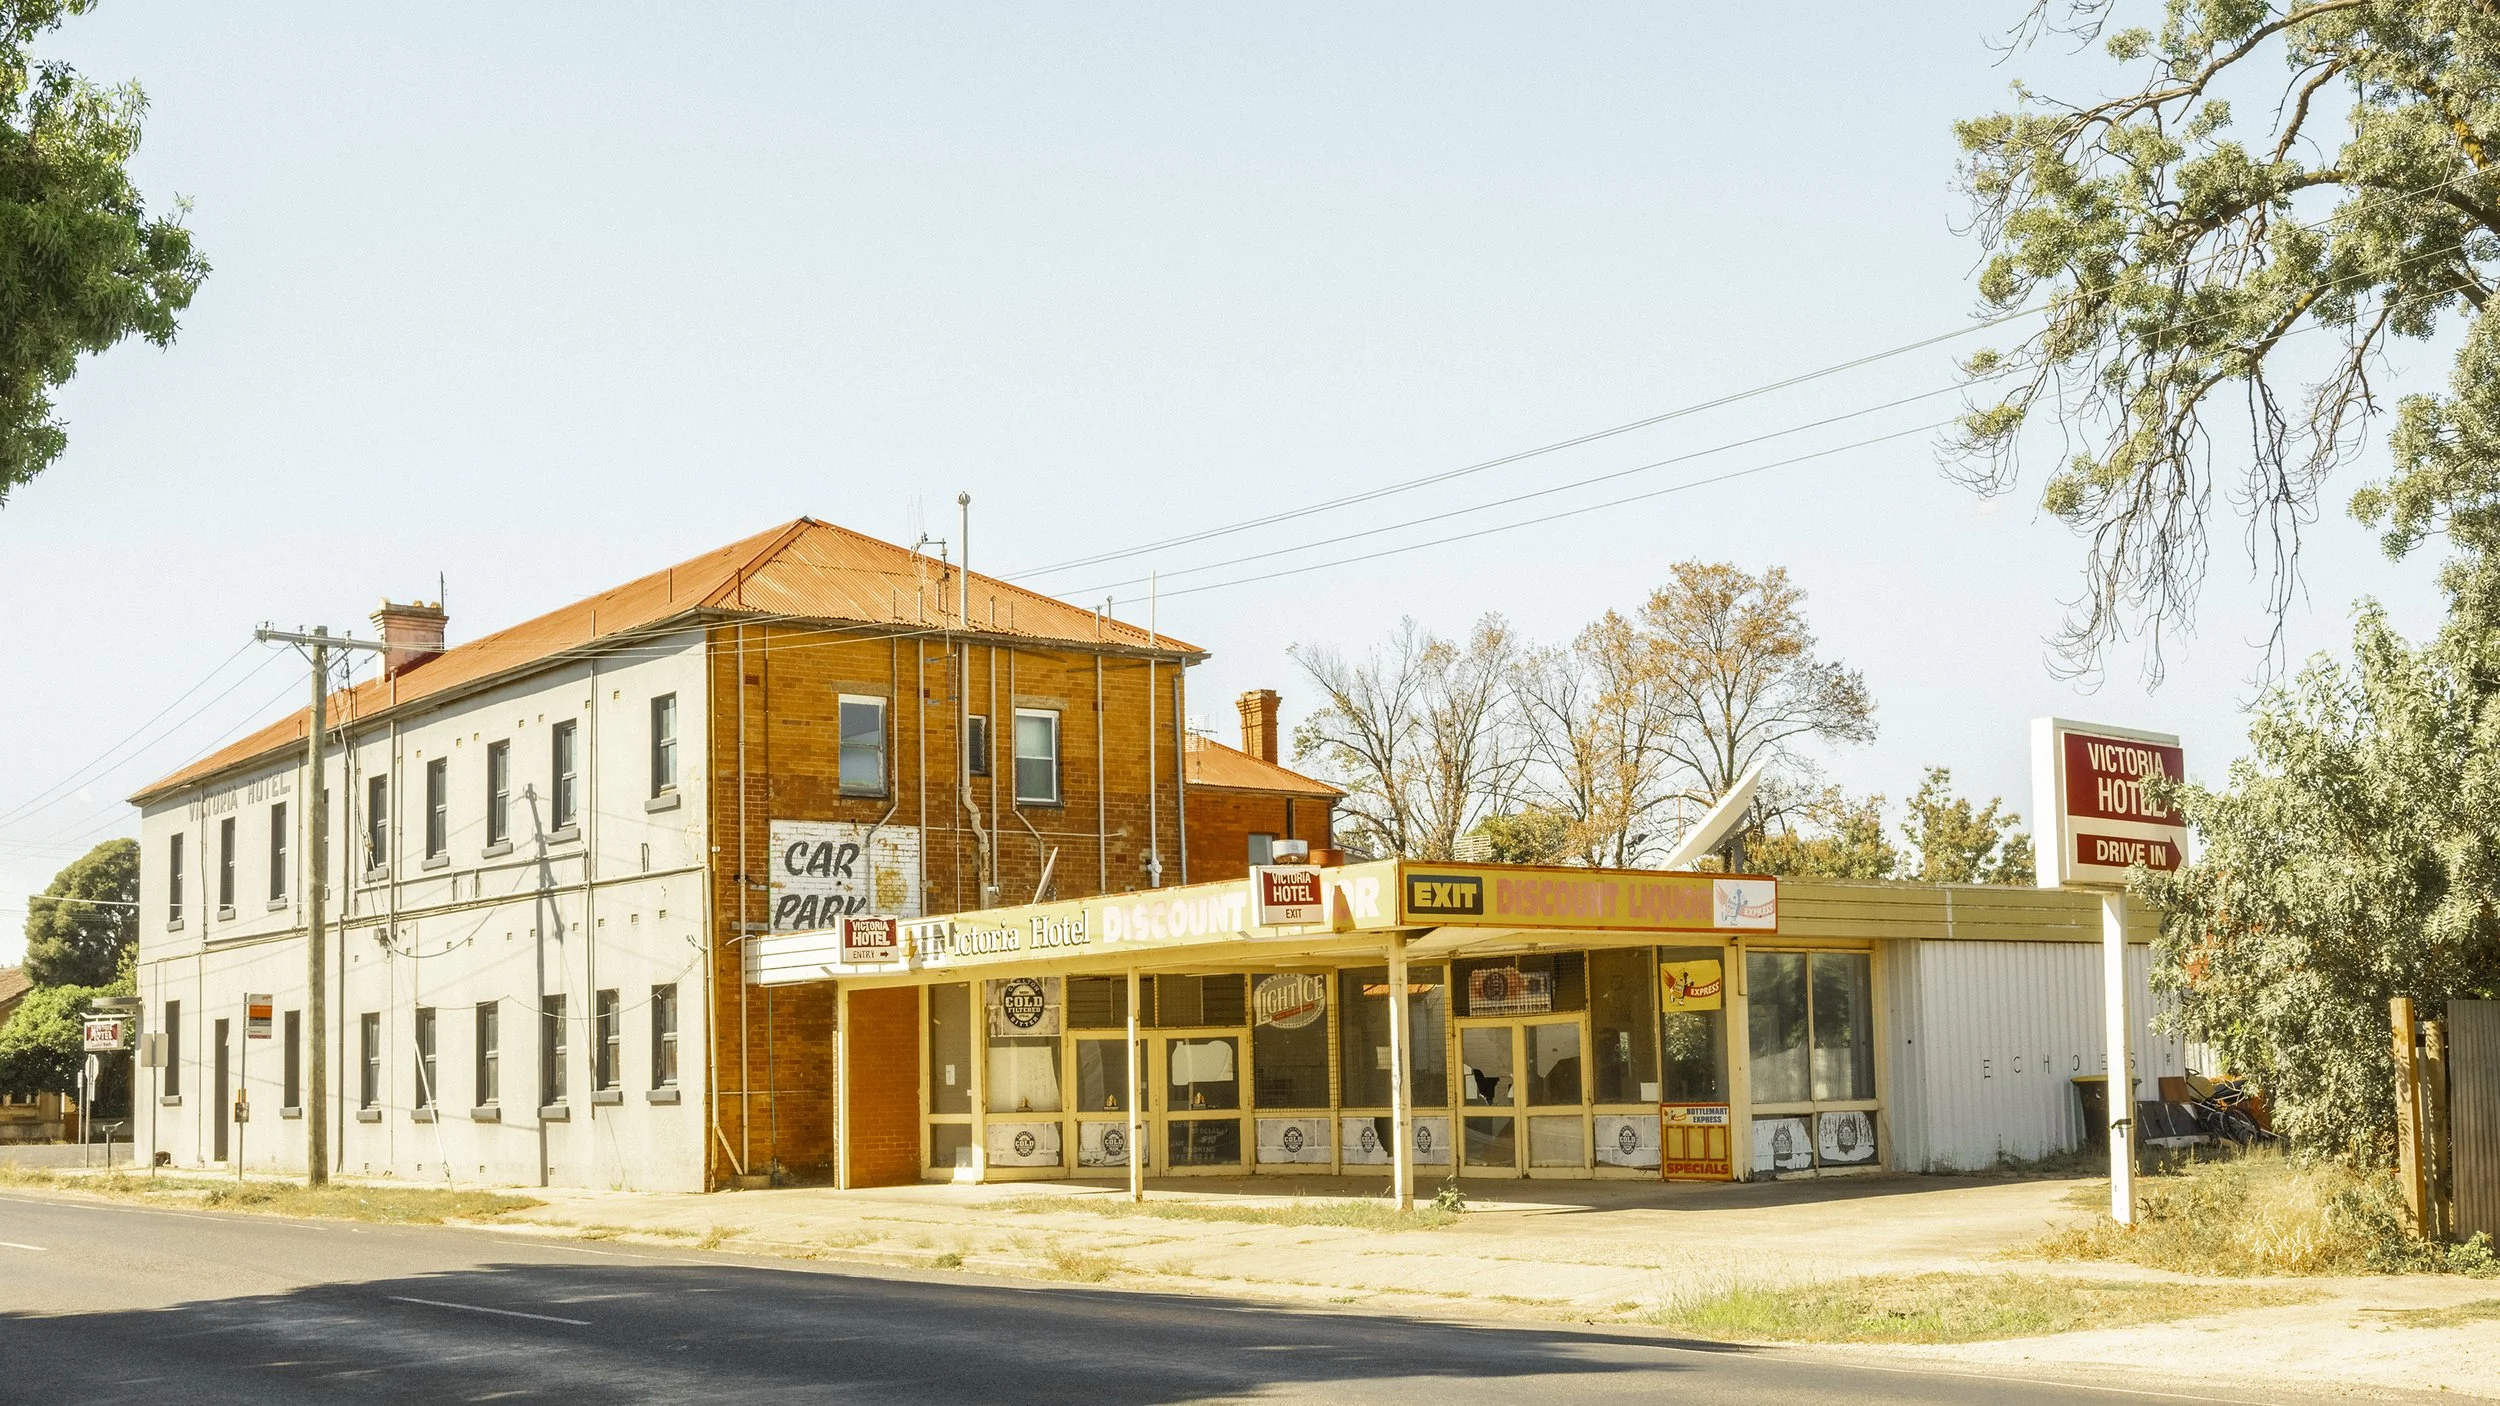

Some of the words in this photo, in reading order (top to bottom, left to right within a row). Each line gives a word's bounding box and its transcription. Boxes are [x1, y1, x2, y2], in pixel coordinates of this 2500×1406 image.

[2087, 742, 2166, 781] VICTORIA
[784, 840, 861, 879] CAR
[2096, 839, 2146, 864] DRIVE
[2150, 844, 2167, 867] IN
[1272, 871, 1312, 885] VICTORIA
[1273, 884, 1314, 903] HOTEL
[1413, 881, 1478, 909] EXIT
[1496, 879, 1619, 919] DISCOUNT
[1628, 883, 1713, 925] LIQUOR
[1744, 903, 1774, 916] EXPRESS
[773, 893, 868, 930] PARK
[1103, 891, 1248, 944] DISCOUNT
[1285, 908, 1302, 919] EXIT
[852, 920, 890, 932] VICTORIA
[954, 918, 1022, 958] ictoria
[1029, 908, 1092, 950] Hotel
[852, 930, 891, 946] HOTEL
[853, 950, 876, 959] ENTRY
[1690, 982, 1720, 996] EXPRESS
[1005, 996, 1043, 1008] COLD
[1255, 982, 1297, 1027] LIGHT
[1010, 1016, 1039, 1028] BITTER
[1686, 1107, 1728, 1116] BOTTLEMART
[1666, 1163, 1729, 1175] SPECIALS
